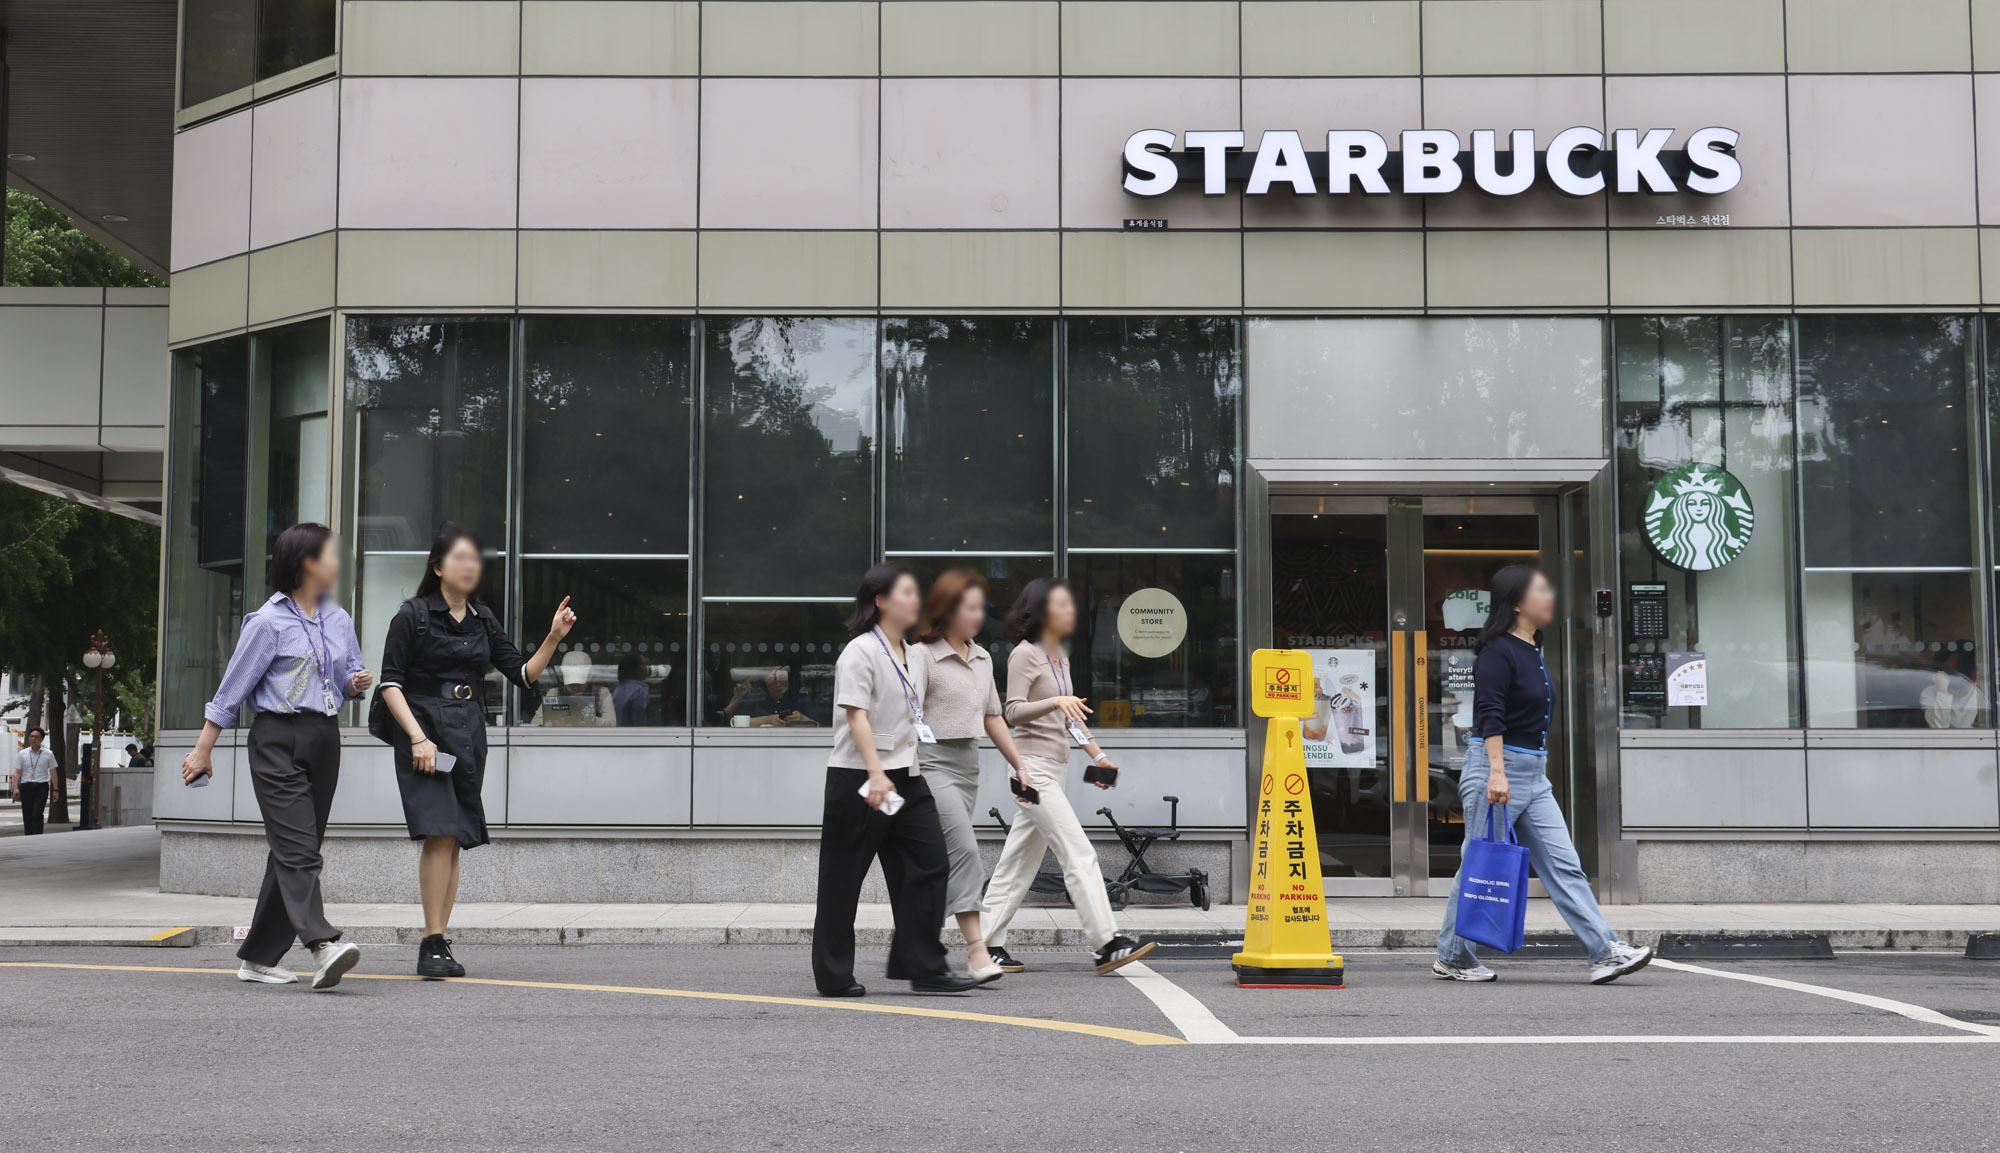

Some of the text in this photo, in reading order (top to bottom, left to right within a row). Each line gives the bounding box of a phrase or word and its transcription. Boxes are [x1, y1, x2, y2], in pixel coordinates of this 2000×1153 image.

[1123, 127, 1742, 197] STARBUCKS
[1129, 219, 1163, 228] 휴게음식점
[1656, 214, 1730, 226] 스타벅스 적선점
[1445, 587, 1479, 601] Cold
[1287, 635, 1375, 646] STARBUCKS
[1448, 673, 1467, 681] after
[1269, 684, 1298, 692] 주차금지
[1257, 800, 1271, 880] 주차금지
[1283, 800, 1307, 880] 주차금지
[1251, 893, 1271, 901] PARKING
[1280, 893, 1319, 901] PARKING
[1292, 906, 1311, 914] 협조에
[1284, 914, 1320, 923] 감사드립니다
